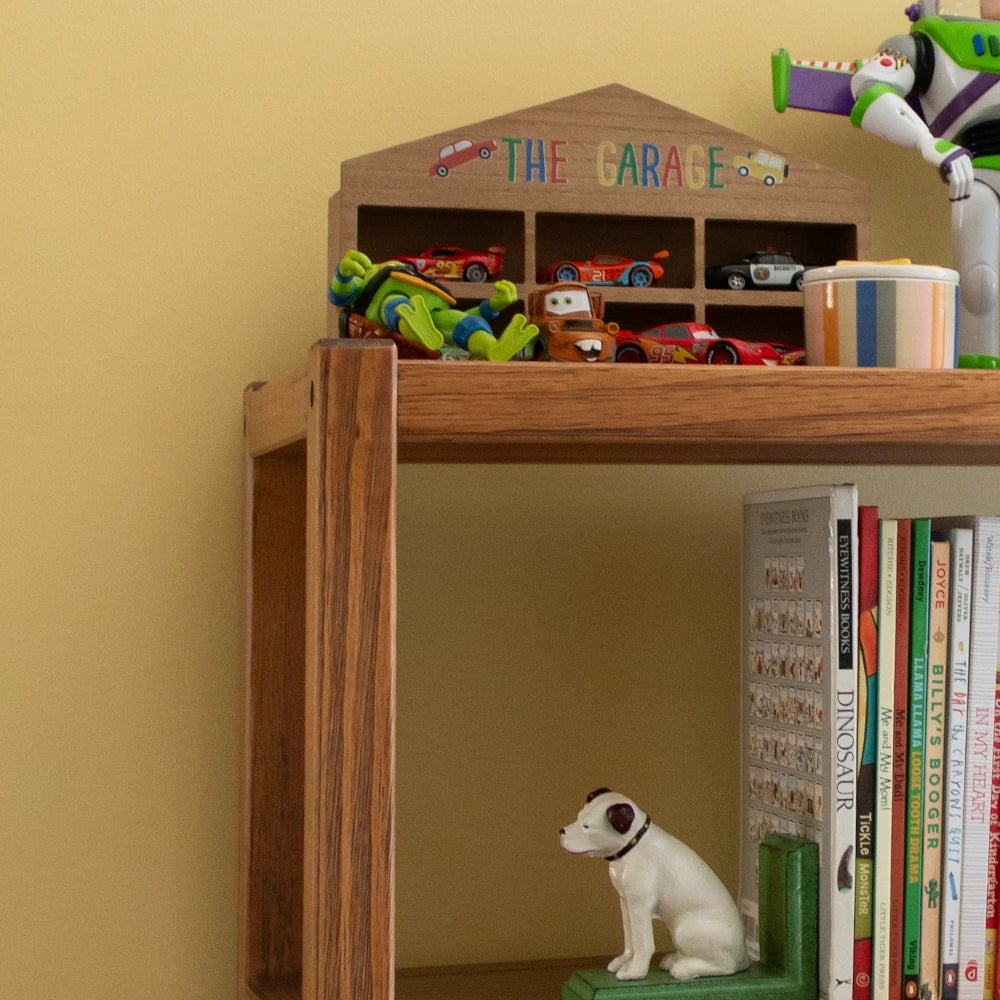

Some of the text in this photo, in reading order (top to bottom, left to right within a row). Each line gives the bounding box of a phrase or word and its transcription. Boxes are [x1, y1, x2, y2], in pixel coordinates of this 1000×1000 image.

[501, 137, 725, 190] THE GARAGE
[592, 270, 606, 282] 21
[839, 535, 851, 654] EYEWITNESS BOOKS
[916, 560, 926, 602] Dewdney
[935, 558, 946, 609] JOYCE
[836, 690, 854, 812] DINOSAUR
[880, 706, 893, 810] Me and My Mom!
[894, 709, 905, 802] Me and My Dad!
[909, 658, 924, 884] LLAMA LLAMA LOOSE TOOTH DRAMA
[926, 664, 944, 848] BILLY'S BOOGER
[949, 662, 966, 864] THE DAY CRAYONS QUIT
[971, 708, 989, 824] IN MY HEART
[990, 814, 1000, 826] of
[986, 833, 1000, 918] Kindergarten
[906, 940, 917, 970] Viking
